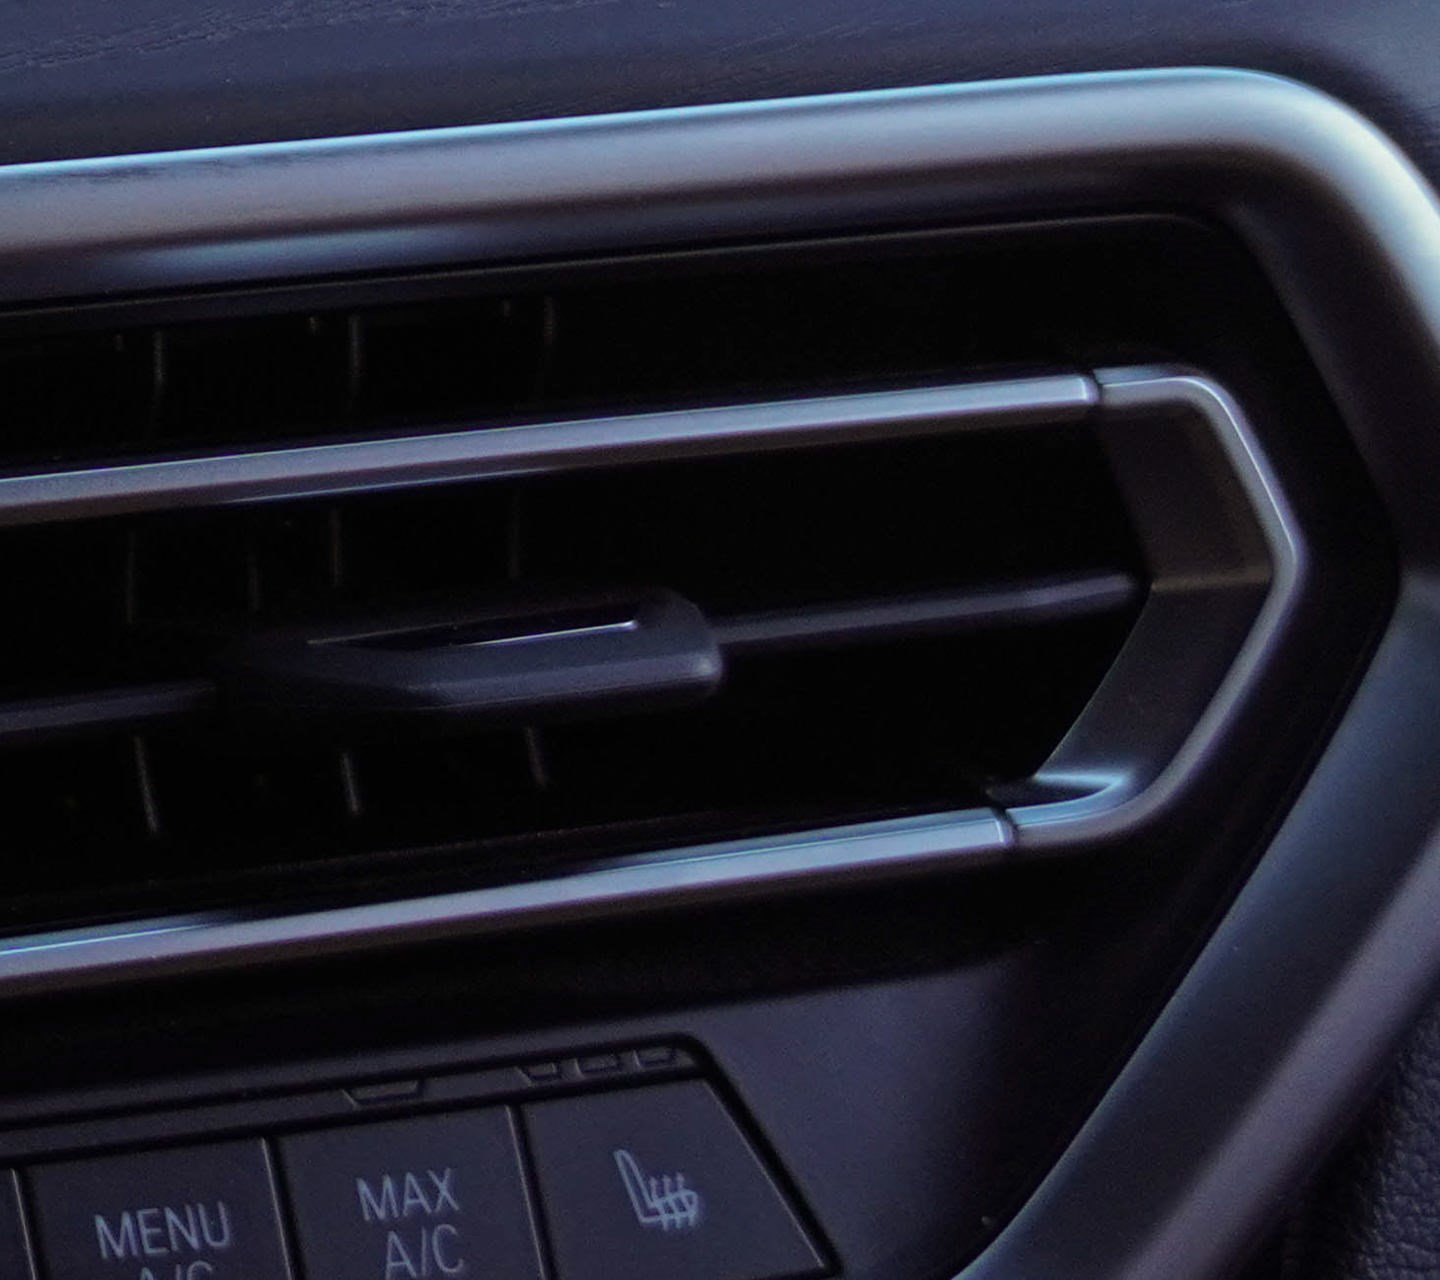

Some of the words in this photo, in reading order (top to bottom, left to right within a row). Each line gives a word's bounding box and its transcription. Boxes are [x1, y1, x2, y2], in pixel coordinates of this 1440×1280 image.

[355, 1167, 461, 1224] MAX
[94, 1200, 233, 1261] MENU
[383, 1223, 465, 1280] A/C
